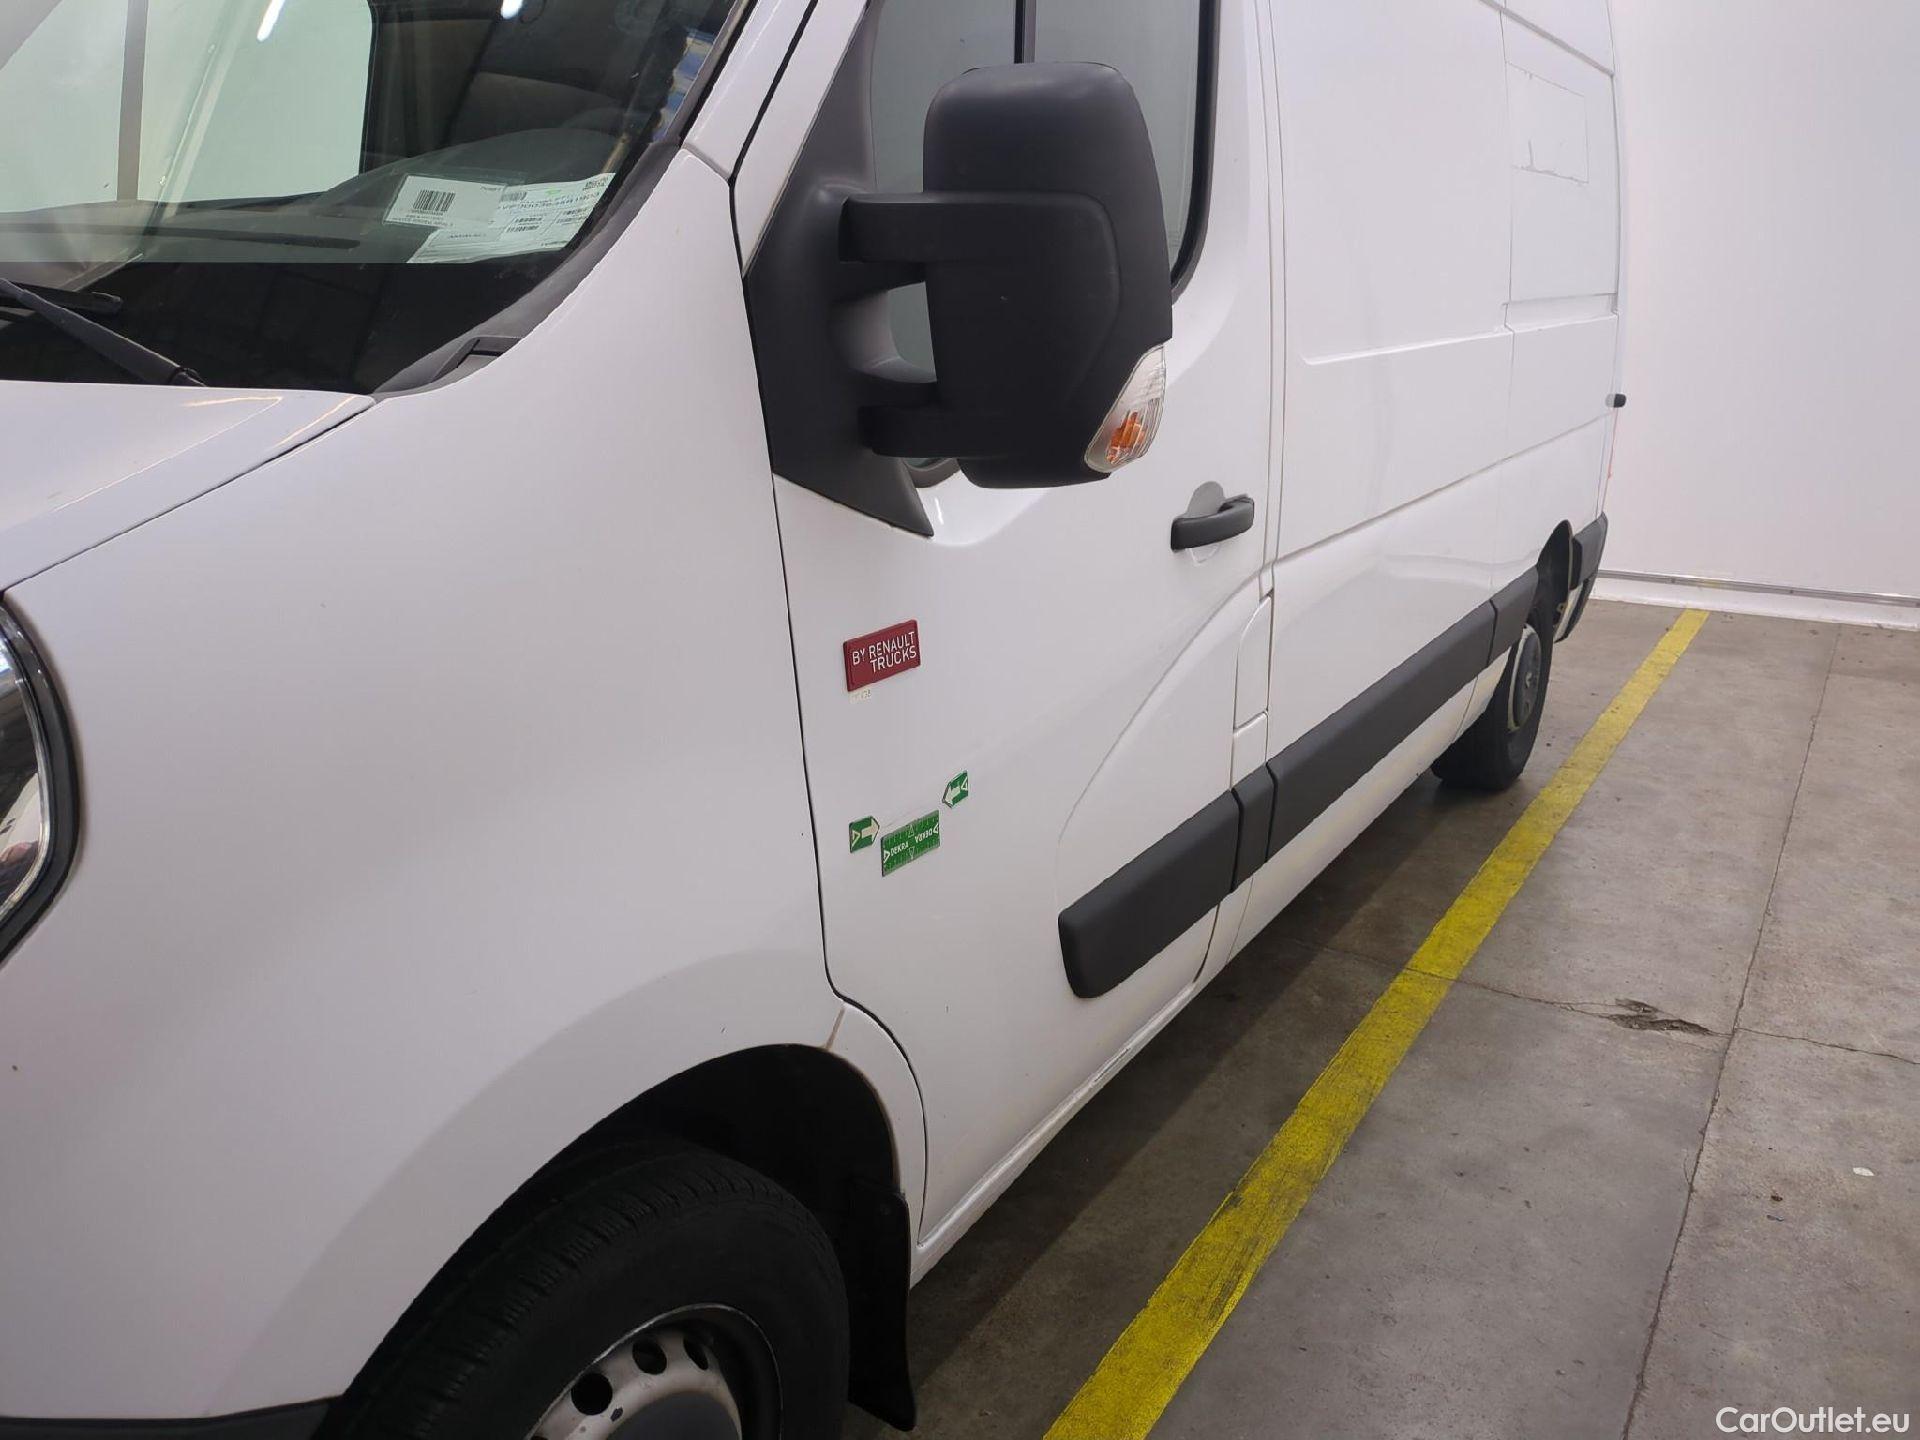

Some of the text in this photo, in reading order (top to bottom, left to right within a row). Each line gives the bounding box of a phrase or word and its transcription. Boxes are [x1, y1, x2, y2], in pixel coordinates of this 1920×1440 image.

[852, 631, 915, 665] BY RENAULT
[869, 645, 917, 673] TRUCKS
[914, 828, 933, 843] DEKRA
[890, 841, 909, 857] DEKRA
